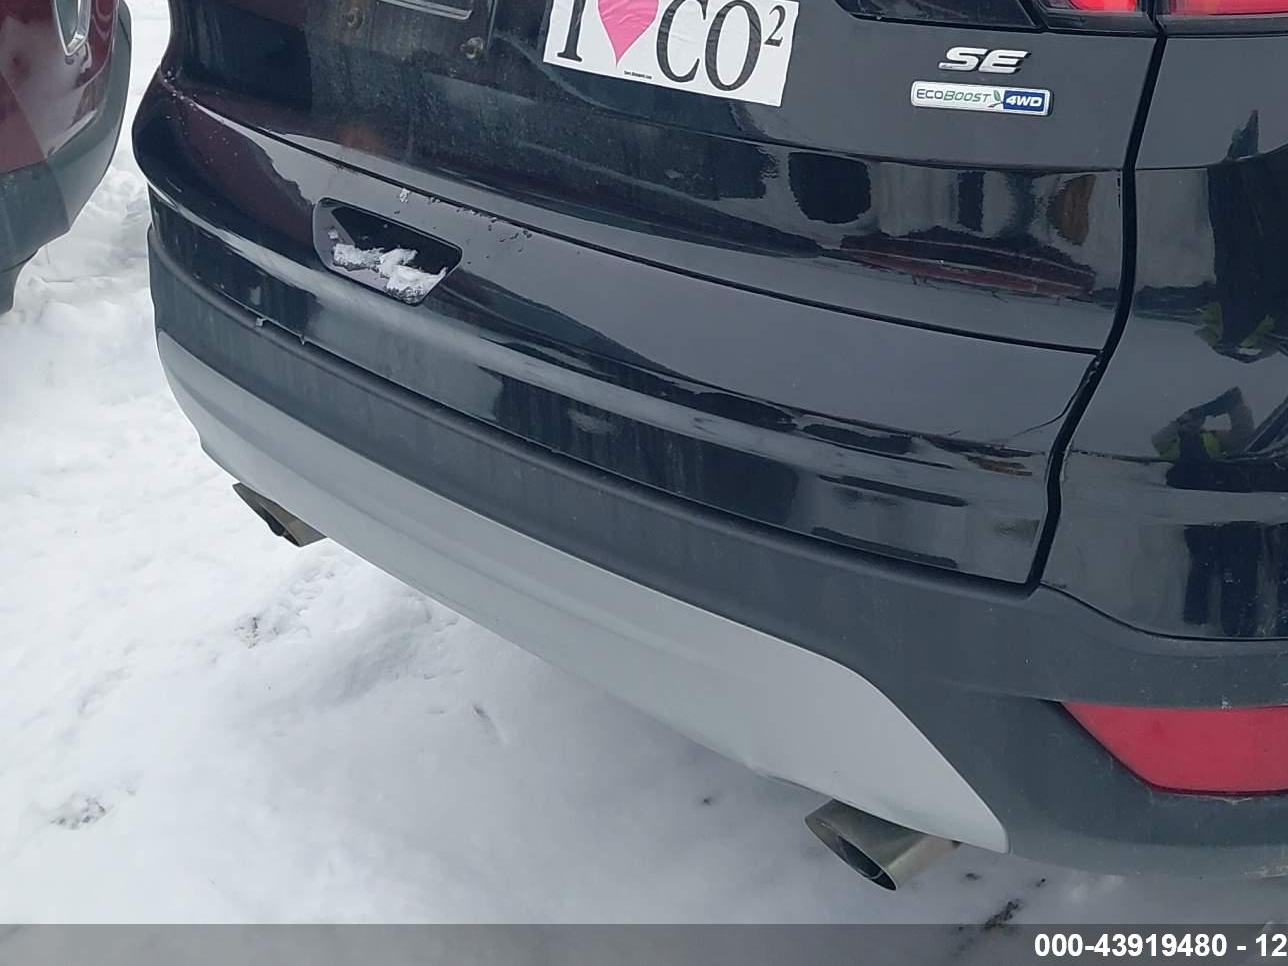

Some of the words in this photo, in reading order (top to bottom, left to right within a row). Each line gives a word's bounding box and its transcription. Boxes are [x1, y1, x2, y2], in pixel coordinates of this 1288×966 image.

[938, 46, 1030, 74] SE
[916, 87, 992, 104] ECOBOOST
[1004, 94, 1044, 108] 4WD
